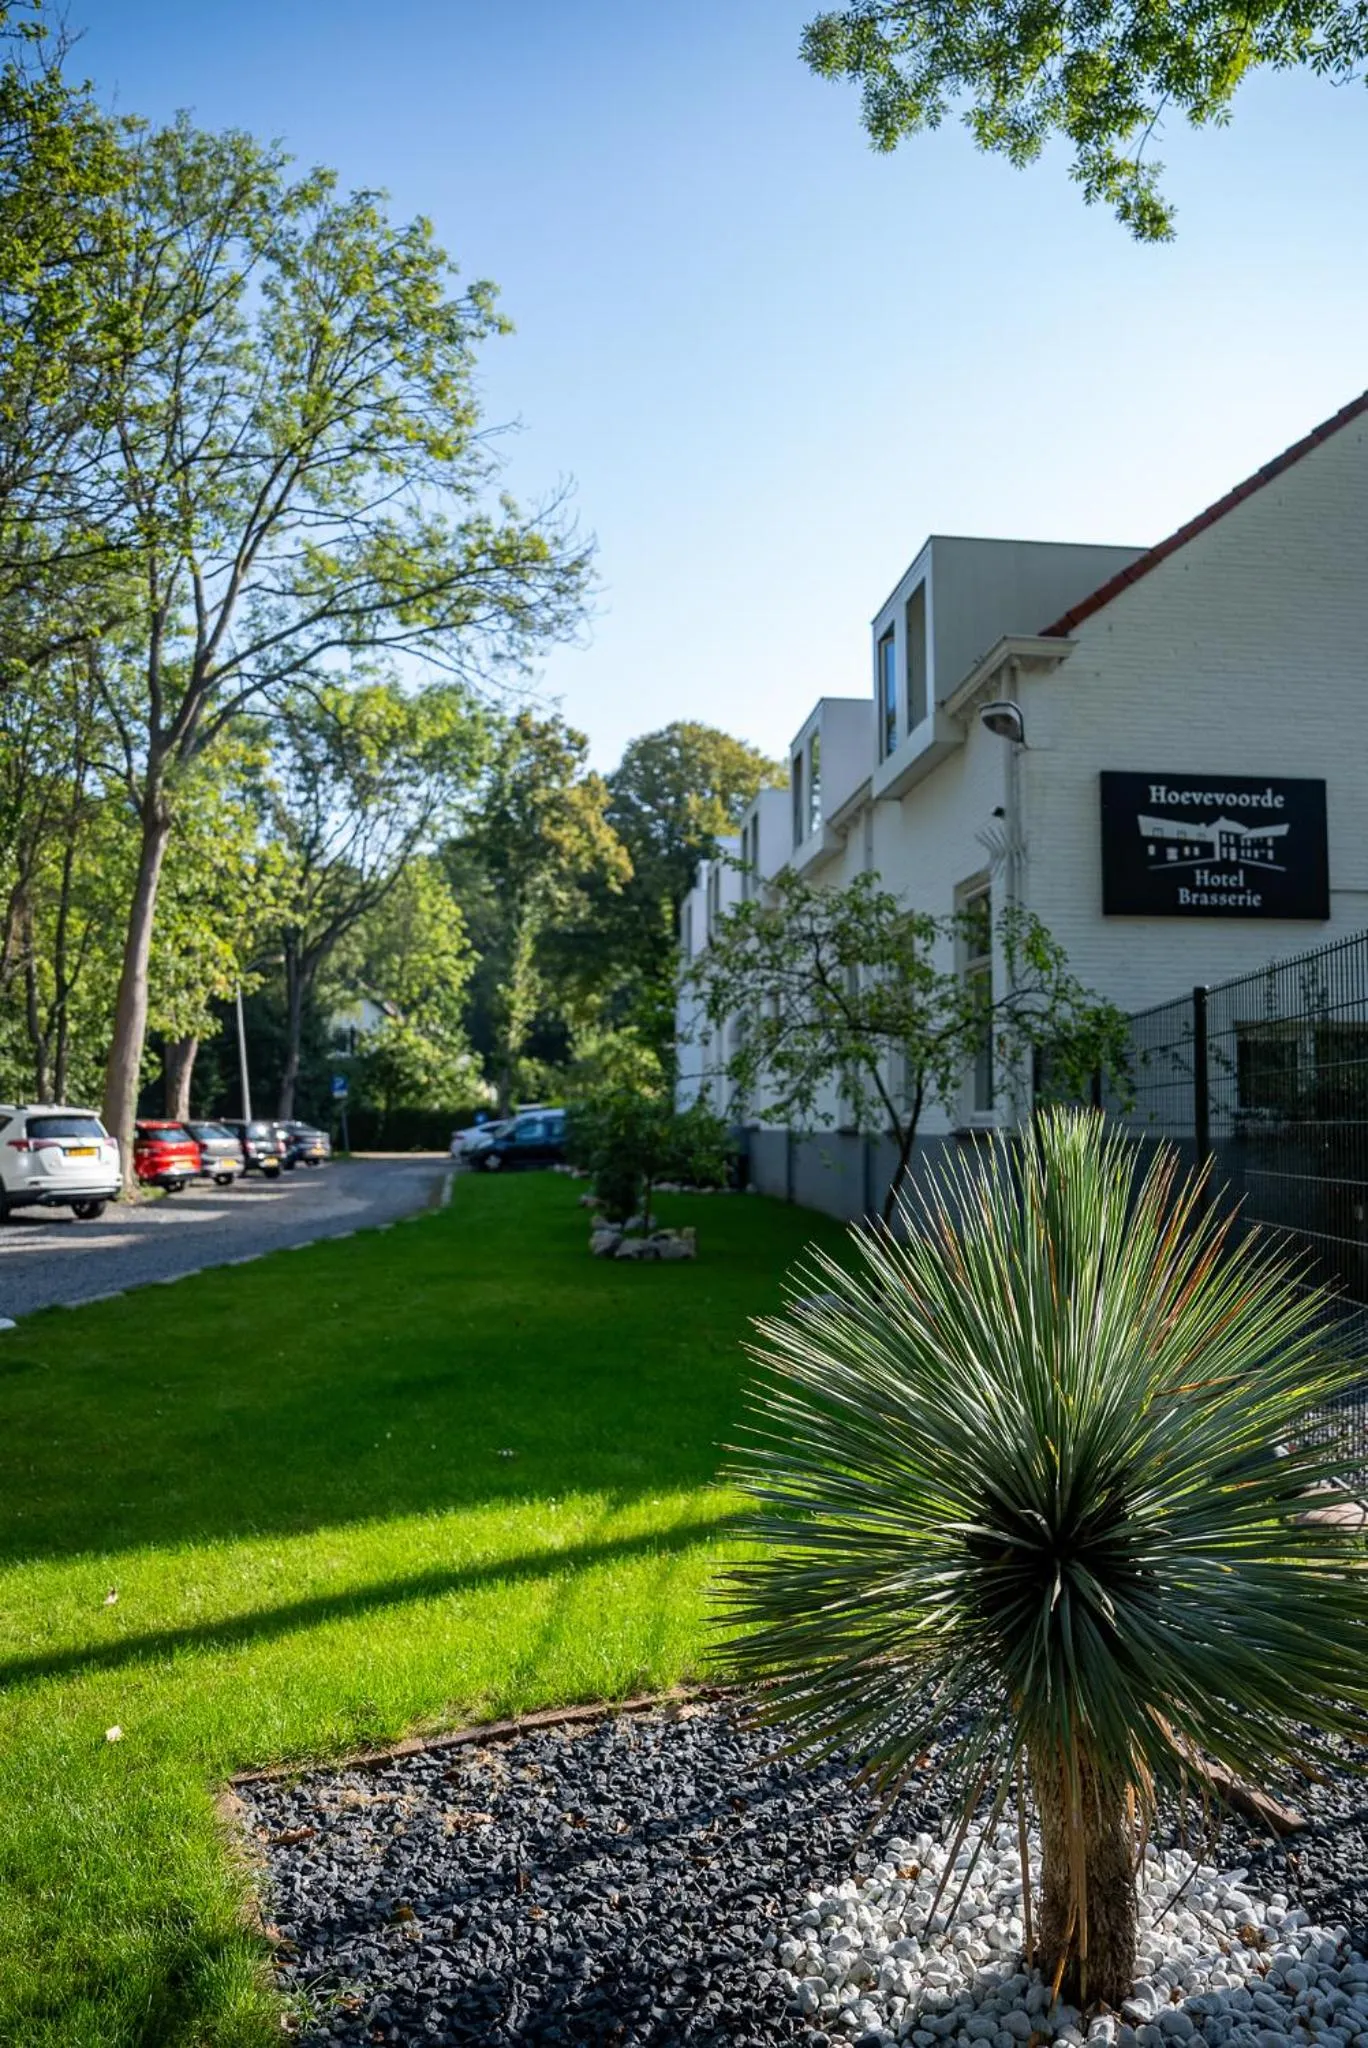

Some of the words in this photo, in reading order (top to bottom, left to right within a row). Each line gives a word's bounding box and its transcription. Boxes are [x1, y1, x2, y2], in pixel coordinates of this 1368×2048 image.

[1149, 785, 1285, 808] Hoevevoorde
[1195, 869, 1245, 887] Hotel
[1178, 888, 1262, 907] Brasserie
